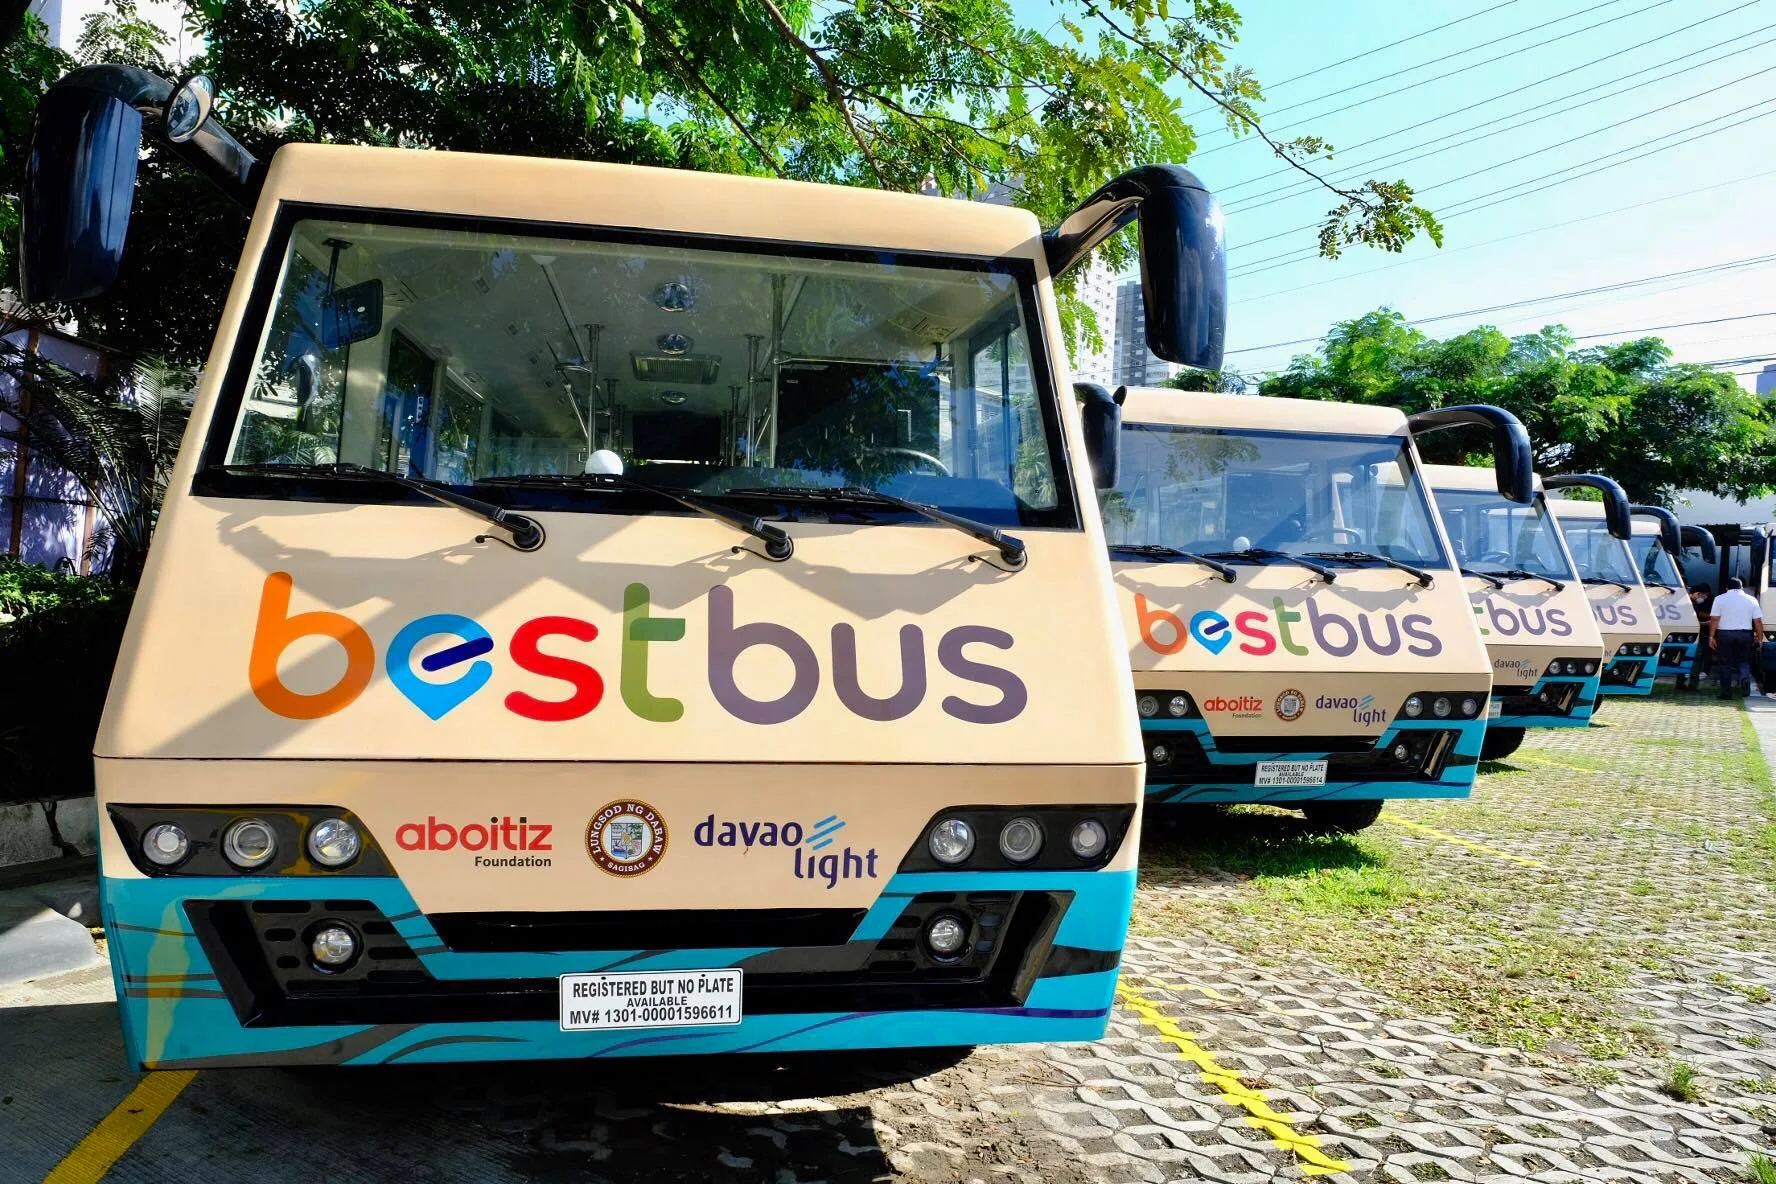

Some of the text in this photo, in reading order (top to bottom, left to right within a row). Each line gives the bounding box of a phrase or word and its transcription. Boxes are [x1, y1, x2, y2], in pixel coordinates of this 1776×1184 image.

[1494, 659, 1521, 669] davao
[1516, 668, 1538, 680] light
[1203, 696, 1263, 711] aboitiz
[1315, 694, 1358, 709] davao
[1353, 709, 1386, 727] light
[395, 816, 553, 851] aboitiz
[590, 803, 664, 855] LUNGSOD NG DABAW
[693, 813, 804, 847] davao
[474, 855, 552, 867] Foundation
[607, 861, 646, 872] SAGISAG
[794, 847, 879, 890] light
[573, 977, 734, 998] REGISTERED BUT NO PLATE
[626, 995, 688, 1008] AVAILABLE
[569, 1004, 733, 1025] MV# 1301-00001596611
